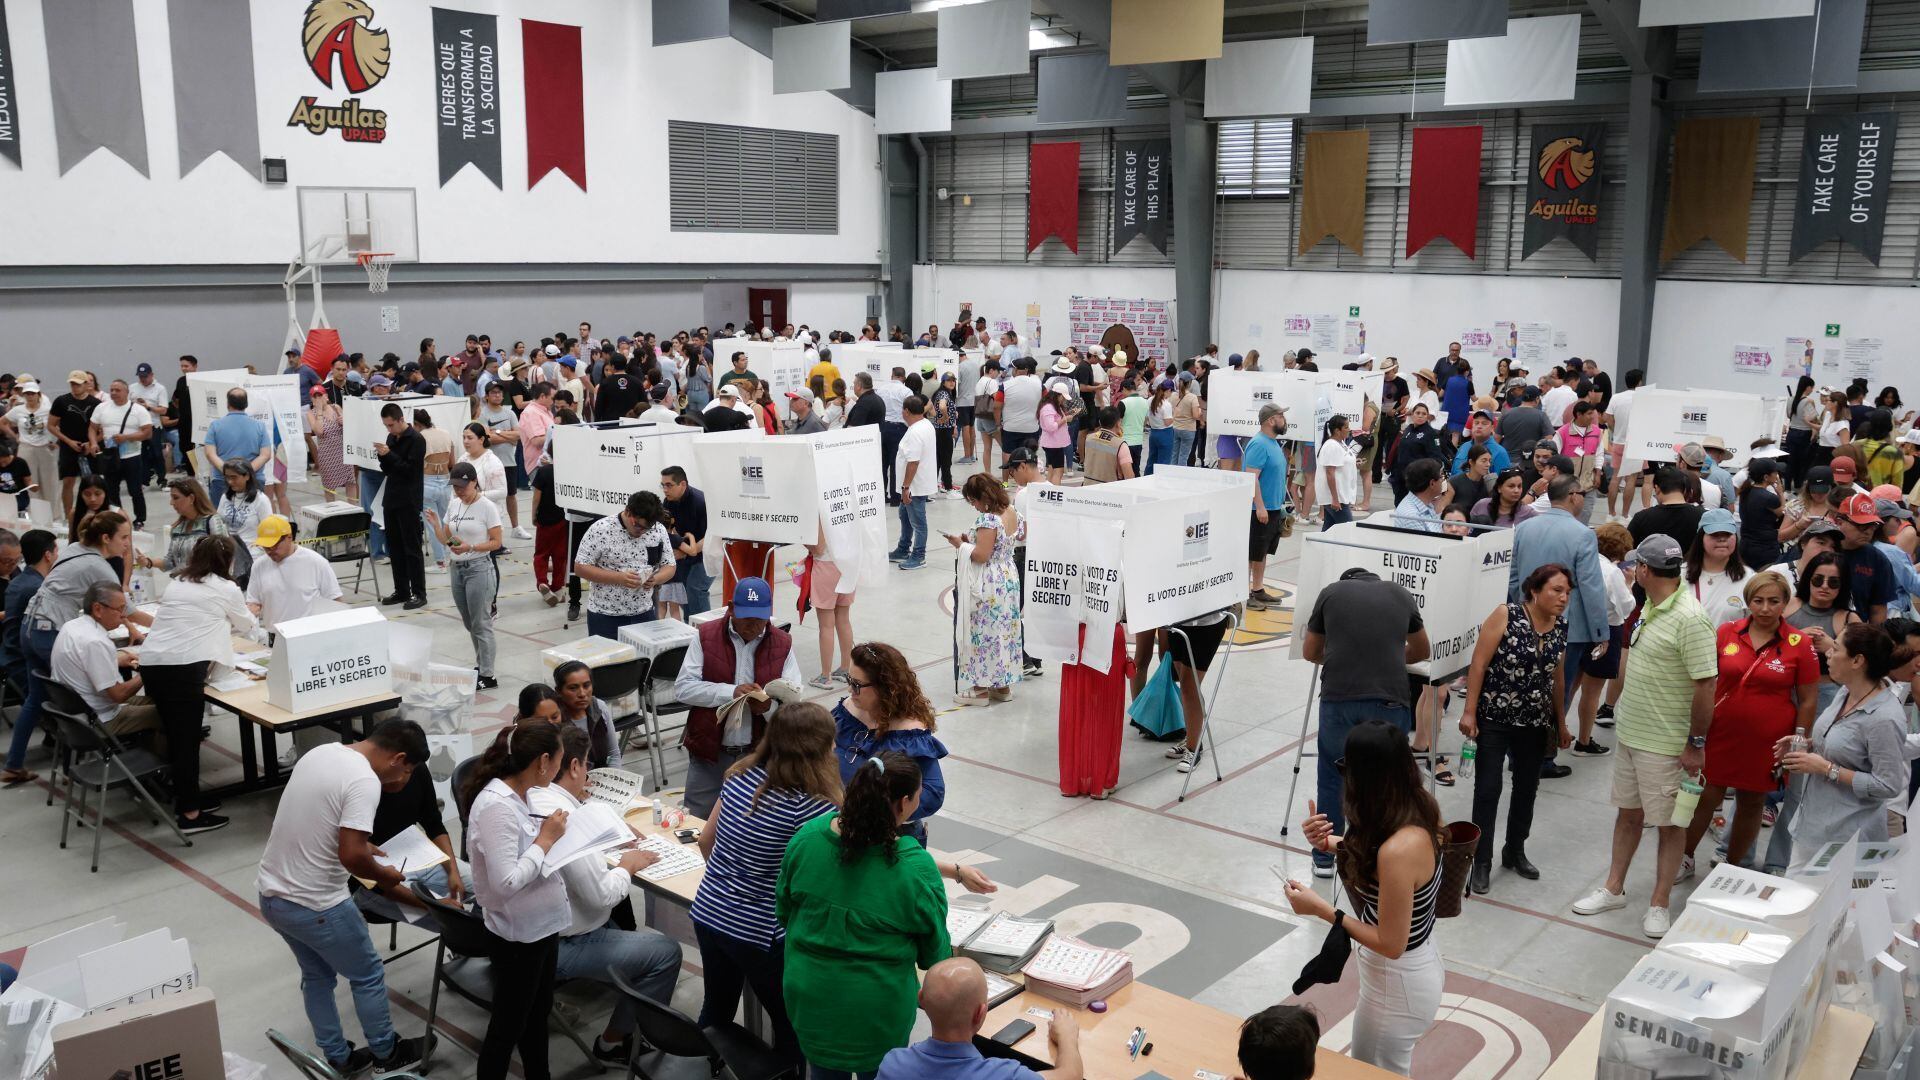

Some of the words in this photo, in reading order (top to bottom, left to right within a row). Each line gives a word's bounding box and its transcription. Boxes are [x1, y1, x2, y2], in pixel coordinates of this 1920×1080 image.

[459, 28, 473, 39] A
[440, 42, 456, 71] QUE
[479, 45, 494, 110] SOCIEDAD
[460, 41, 476, 140] TRANSFORMEN
[440, 73, 456, 126] LÍDERES
[286, 96, 388, 135] Águilas
[342, 128, 386, 142] UPAEP
[481, 118, 495, 135] LA
[1125, 149, 1137, 165] OF
[1816, 133, 1840, 174] CARE
[1852, 122, 1881, 201] YOURSELF
[1124, 166, 1137, 197] CARE
[1147, 155, 1160, 191] PLACE
[1811, 177, 1835, 215] TAKE
[1123, 198, 1136, 228] TAKE
[1146, 194, 1159, 221] THIS
[1849, 203, 1870, 223] OF
[1260, 392, 1273, 400] IEE
[1690, 412, 1707, 421] IEE
[1099, 431, 1113, 441] IEE
[346, 444, 354, 455] EL
[608, 445, 626, 455] INE
[747, 466, 763, 478] IEE
[559, 483, 575, 498] VOTO
[575, 486, 583, 499] ES
[585, 488, 600, 502] LIBRE
[606, 491, 629, 505] SECRE
[829, 488, 844, 499] VOTO
[844, 486, 851, 496] ES
[856, 482, 870, 493] VOTO
[870, 481, 877, 491] ES
[1047, 490, 1064, 502] IEE
[829, 501, 844, 513] LIBRE
[859, 507, 877, 519] ECRETO
[721, 510, 727, 519] EL
[727, 511, 741, 520] VOTO
[741, 512, 748, 520] ES
[770, 514, 799, 524] SECRETO
[831, 512, 855, 526] SECRETO
[1195, 521, 1209, 539] IEE
[1383, 552, 1394, 567] EL
[1397, 554, 1421, 572] VOTO
[1425, 559, 1437, 574] ES
[1493, 549, 1512, 566] INE
[1028, 559, 1038, 572] EL
[1041, 560, 1063, 575] VOTO
[1066, 563, 1077, 577] ES
[1086, 565, 1105, 580] VOTO
[1106, 569, 1118, 582] ES
[1035, 575, 1060, 590] LIBRE
[1062, 579, 1069, 591] Y
[1102, 584, 1108, 597] Y
[1147, 592, 1156, 603] EL
[1157, 587, 1177, 602] VOTO
[1178, 585, 1187, 596] ES
[1188, 580, 1205, 594] LIBRE
[1210, 571, 1234, 587] SECRETO
[1420, 576, 1427, 590] Y
[747, 588, 758, 601] LA
[1032, 590, 1071, 607] SECRETO
[1432, 639, 1451, 661] VOTO
[1451, 636, 1462, 655] ES
[310, 665, 324, 678] EL
[326, 658, 355, 675] VOTO
[357, 655, 371, 667] ES
[295, 678, 327, 693] LIBRE
[329, 675, 337, 687] Y
[339, 665, 387, 684] SECRETO
[1614, 1011, 1745, 1070] SENADORES
[134, 1053, 183, 1080] IEE
